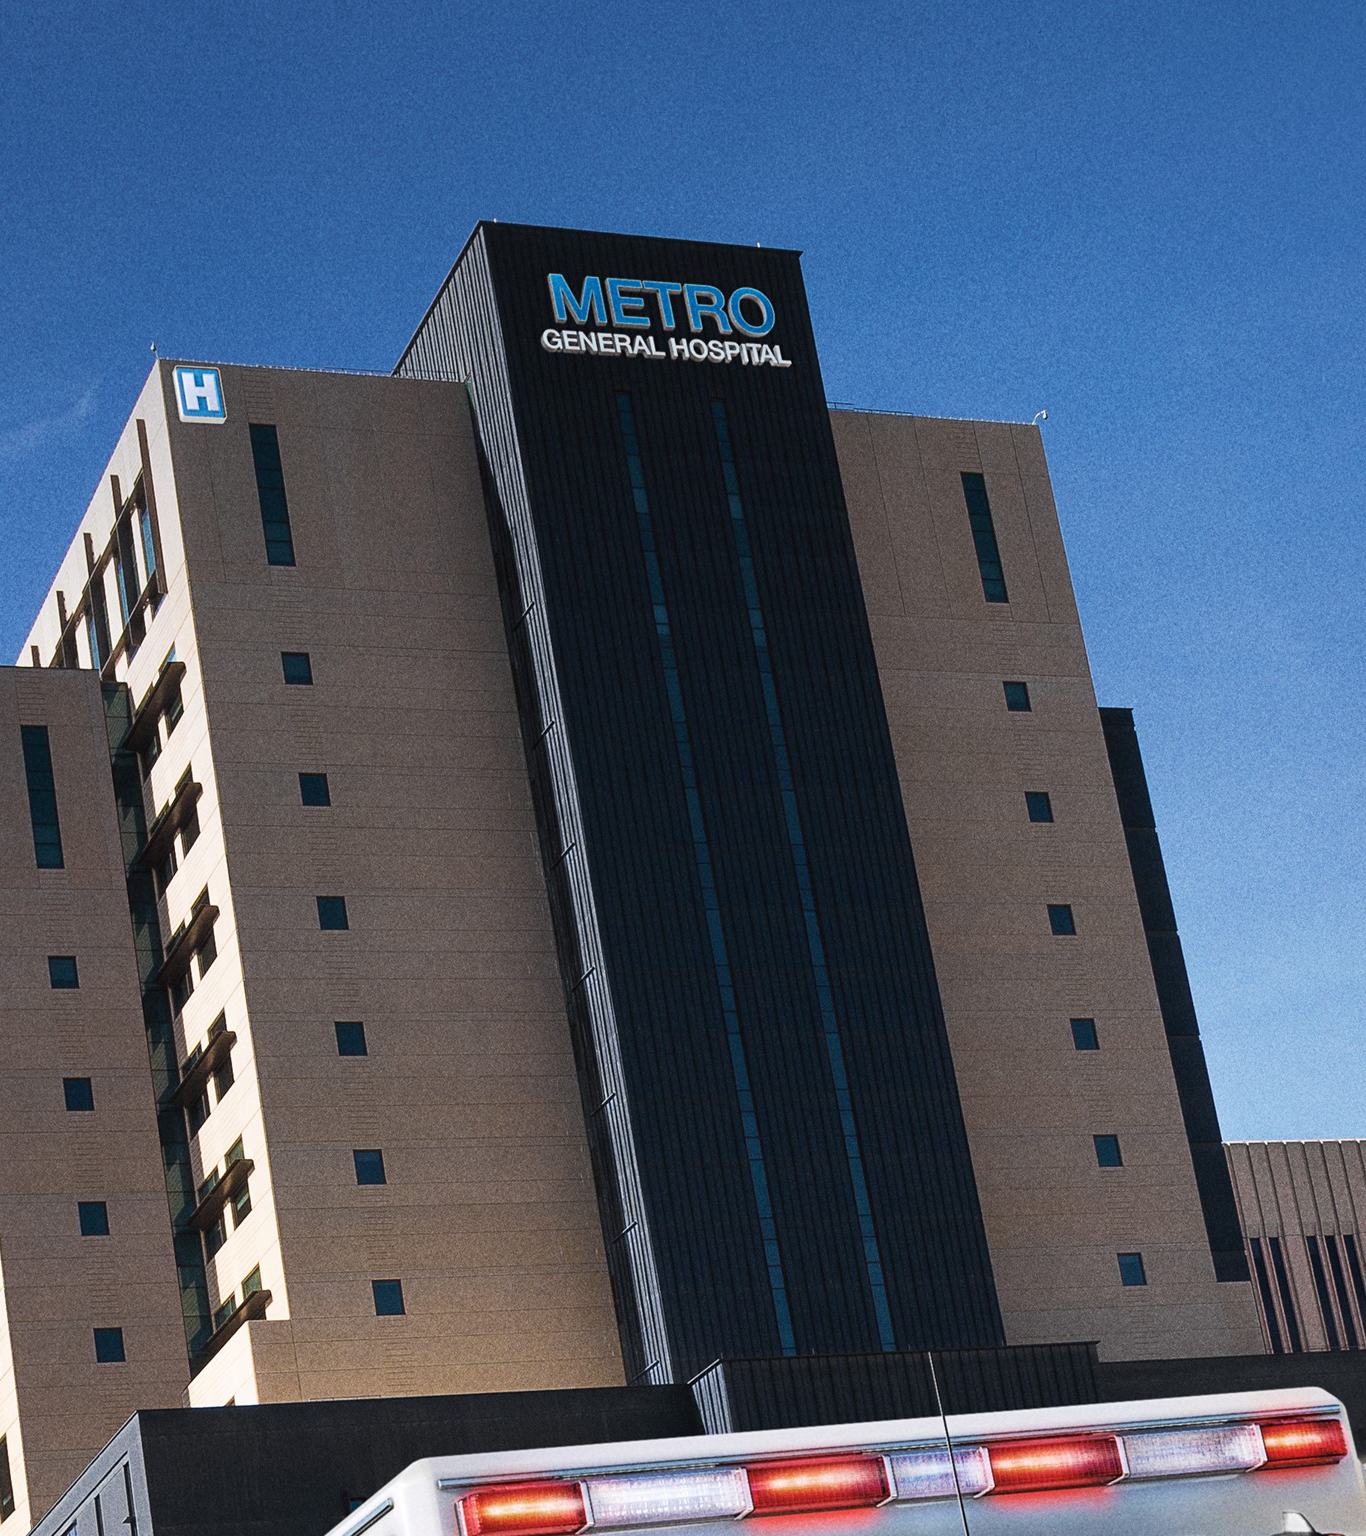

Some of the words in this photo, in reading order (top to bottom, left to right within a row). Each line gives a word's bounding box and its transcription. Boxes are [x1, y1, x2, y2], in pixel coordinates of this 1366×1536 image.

[547, 273, 776, 338] METRO
[541, 329, 666, 358] GENERAL
[668, 337, 792, 367] HOSPITAL
[181, 372, 220, 412] H
